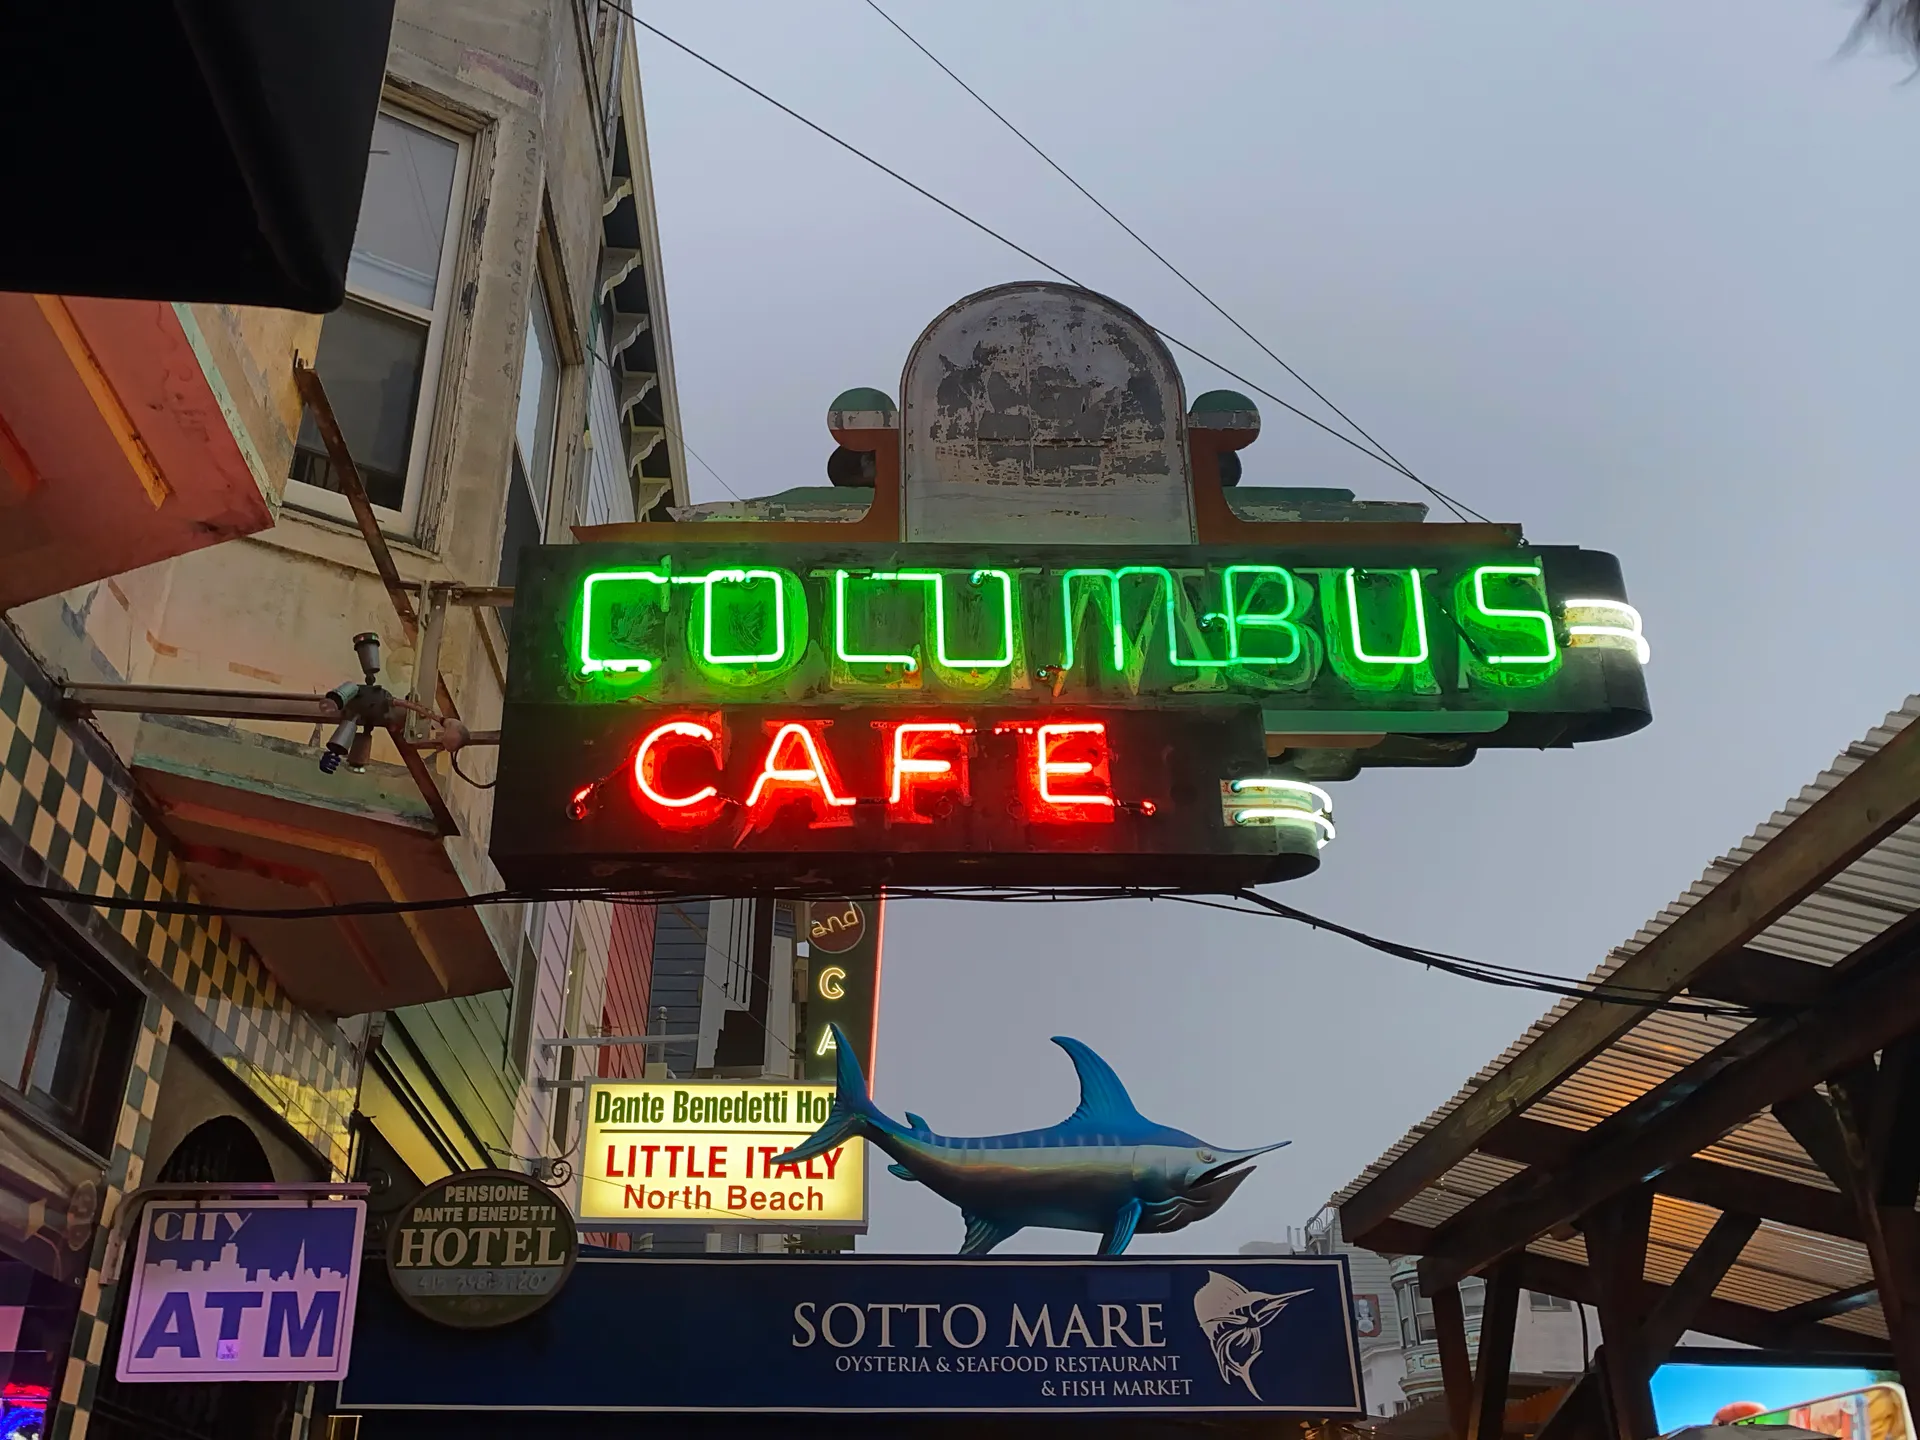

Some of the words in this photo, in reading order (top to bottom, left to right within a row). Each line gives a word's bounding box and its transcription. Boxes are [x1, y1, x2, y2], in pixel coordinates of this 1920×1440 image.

[576, 562, 1560, 692] COLUMBUS
[630, 716, 1114, 822] CAFE
[811, 901, 859, 938] and
[594, 1090, 664, 1124] Dante
[672, 1090, 787, 1124] Benedetti
[796, 1090, 837, 1124] Hot
[605, 1145, 727, 1178] LITTLE
[745, 1146, 844, 1180] ITALY
[444, 1185, 529, 1203] PENSIONE
[623, 1184, 711, 1210] North
[727, 1185, 824, 1211] Beach
[154, 1212, 252, 1242] CITY
[412, 1207, 463, 1223] DANTE
[467, 1206, 557, 1222] BENEDETTI
[396, 1227, 566, 1267] HOTEL
[134, 1291, 341, 1359] ATM
[792, 1302, 987, 1349] SOTTO
[1005, 1303, 1166, 1348] MARE
[835, 1355, 931, 1373] OYSTERIA
[936, 1356, 951, 1372] &
[956, 1356, 1049, 1372] SEAFOOD
[1055, 1355, 1181, 1372] RESTAURANT
[1041, 1380, 1057, 1397] &
[1062, 1380, 1106, 1397] FISH
[1112, 1379, 1193, 1397] MARKET
